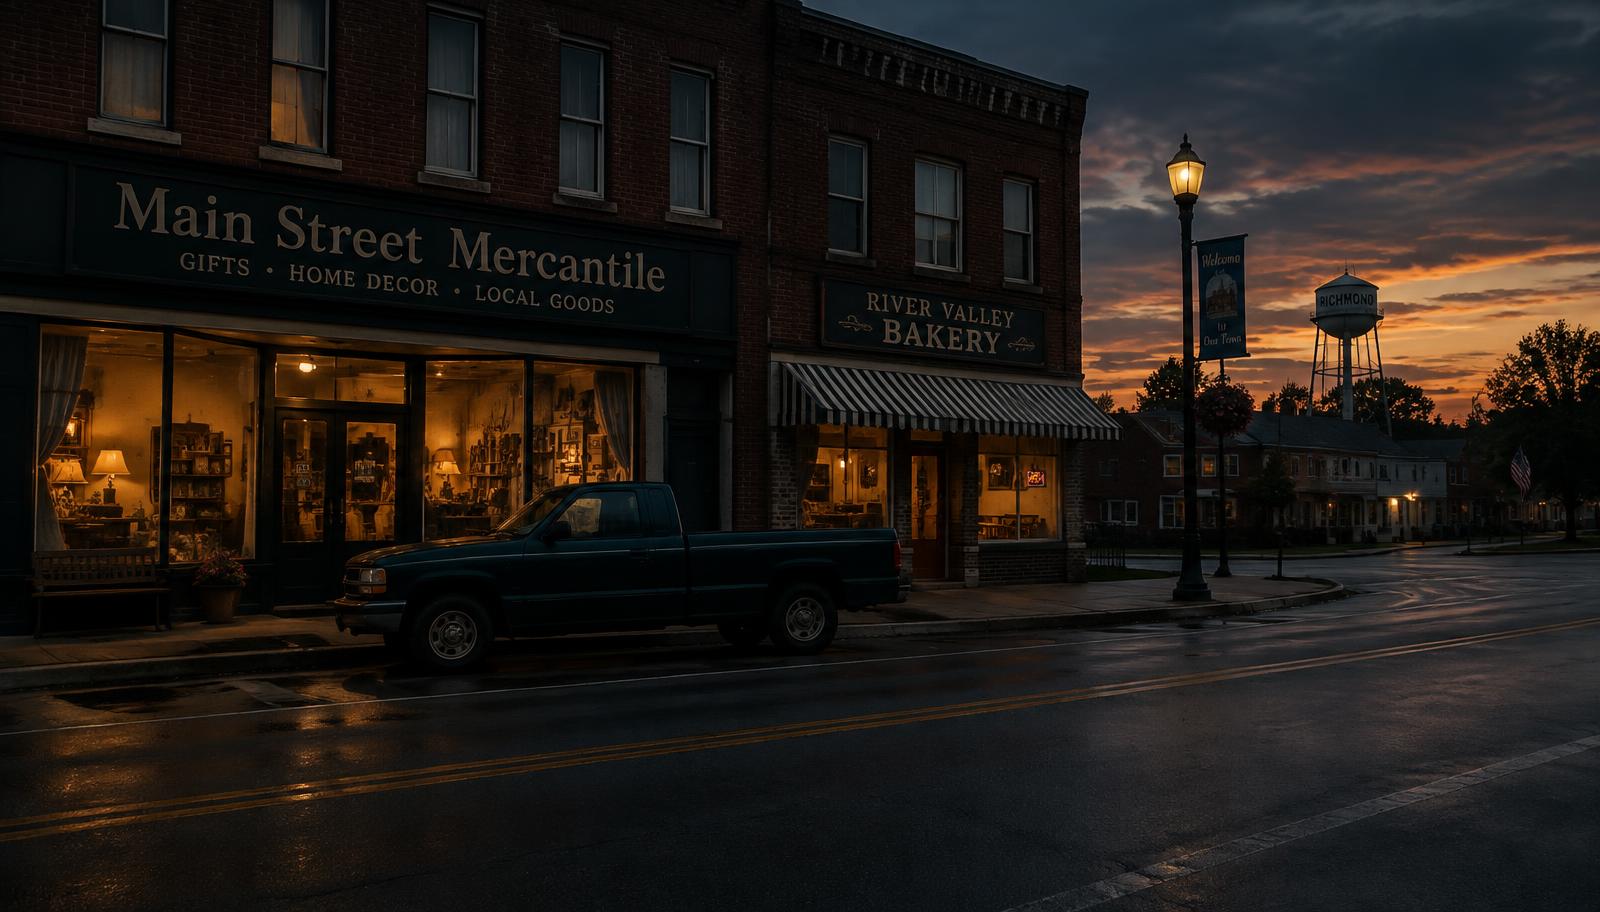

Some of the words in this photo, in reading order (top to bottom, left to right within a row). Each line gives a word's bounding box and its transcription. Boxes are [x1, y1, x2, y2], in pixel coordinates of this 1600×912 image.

[113, 182, 255, 244] Main
[276, 204, 422, 264] Street
[448, 227, 665, 292] Mercantile
[179, 252, 250, 277] GIFTS
[289, 263, 355, 288] HOME
[366, 273, 440, 297] DECOR
[475, 284, 540, 307] LOCAL
[550, 293, 615, 314] GOODS
[866, 291, 931, 316] RIVER
[941, 302, 1014, 328] VALLEY
[882, 318, 1000, 353] BAKERY
